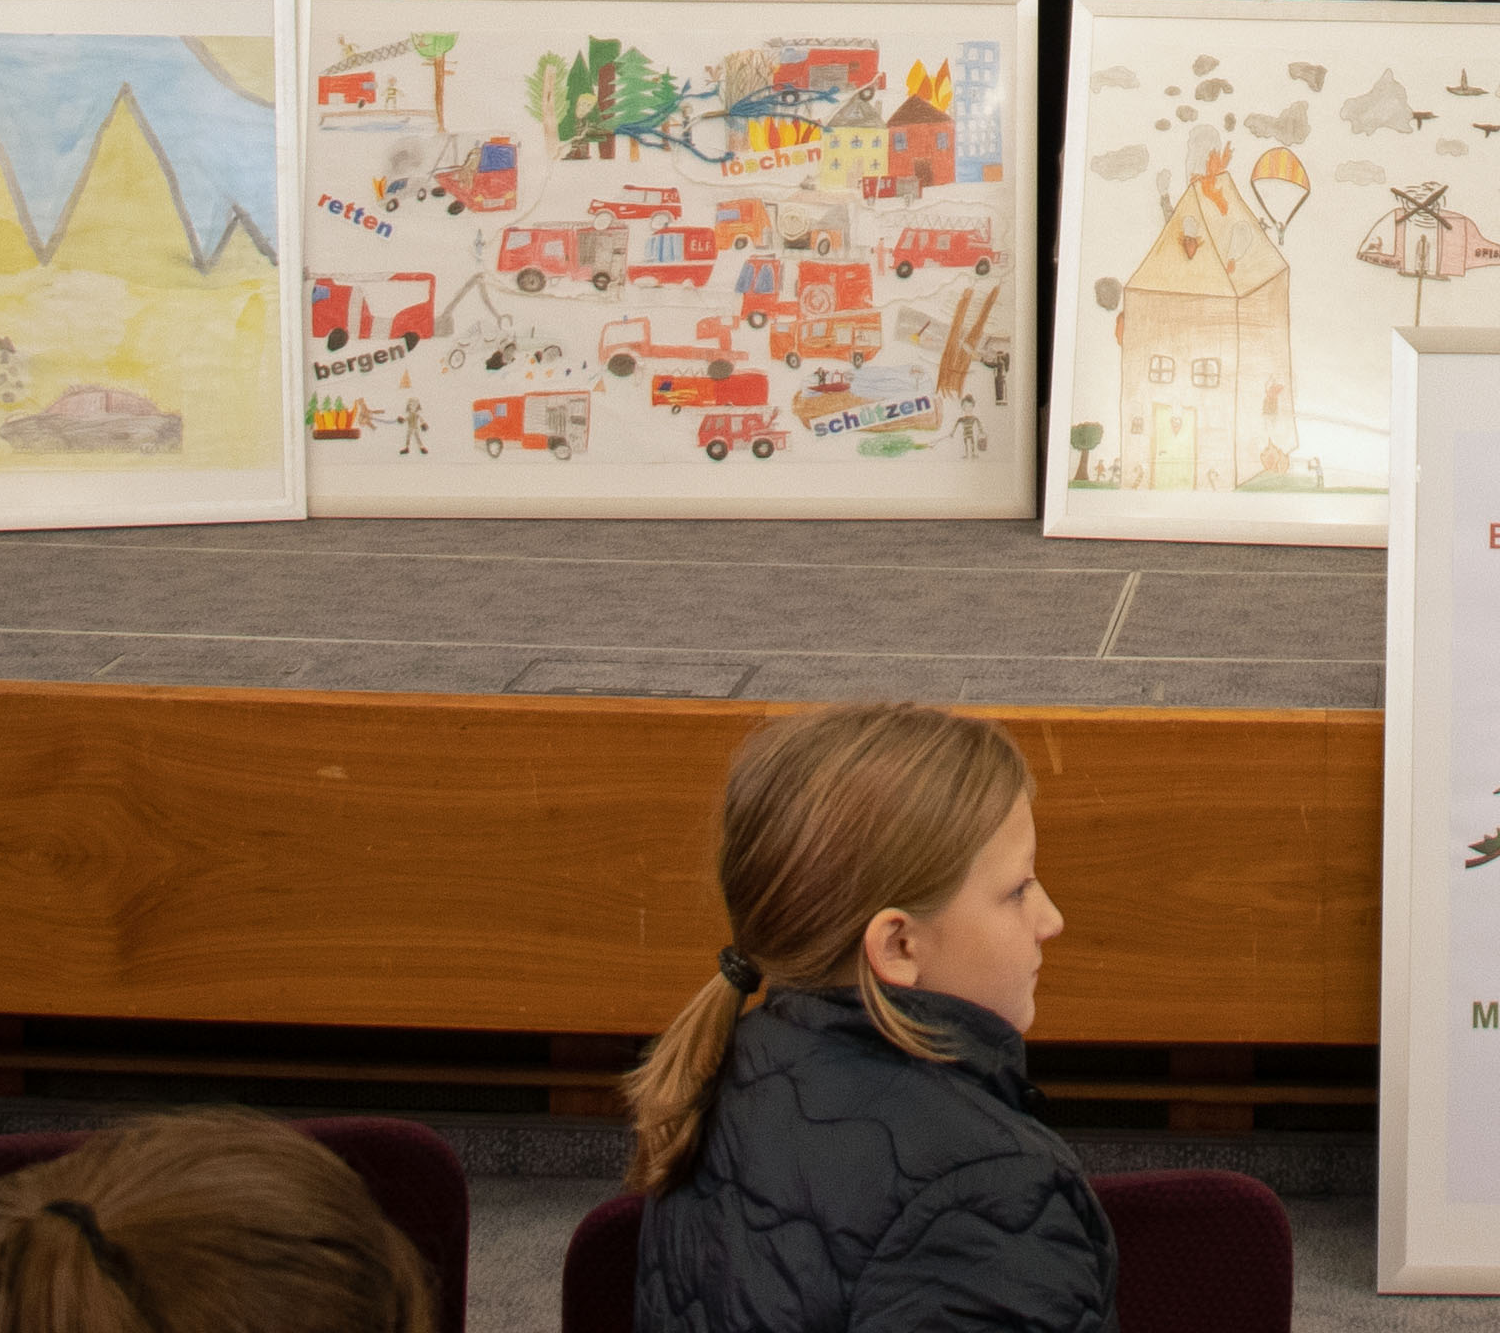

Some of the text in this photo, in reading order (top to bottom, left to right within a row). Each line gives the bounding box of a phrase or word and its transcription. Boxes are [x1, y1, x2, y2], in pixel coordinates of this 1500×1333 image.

[720, 147, 822, 177] löschen
[318, 194, 393, 238] retten
[314, 344, 405, 381] bergen
[814, 396, 931, 437] schützen
